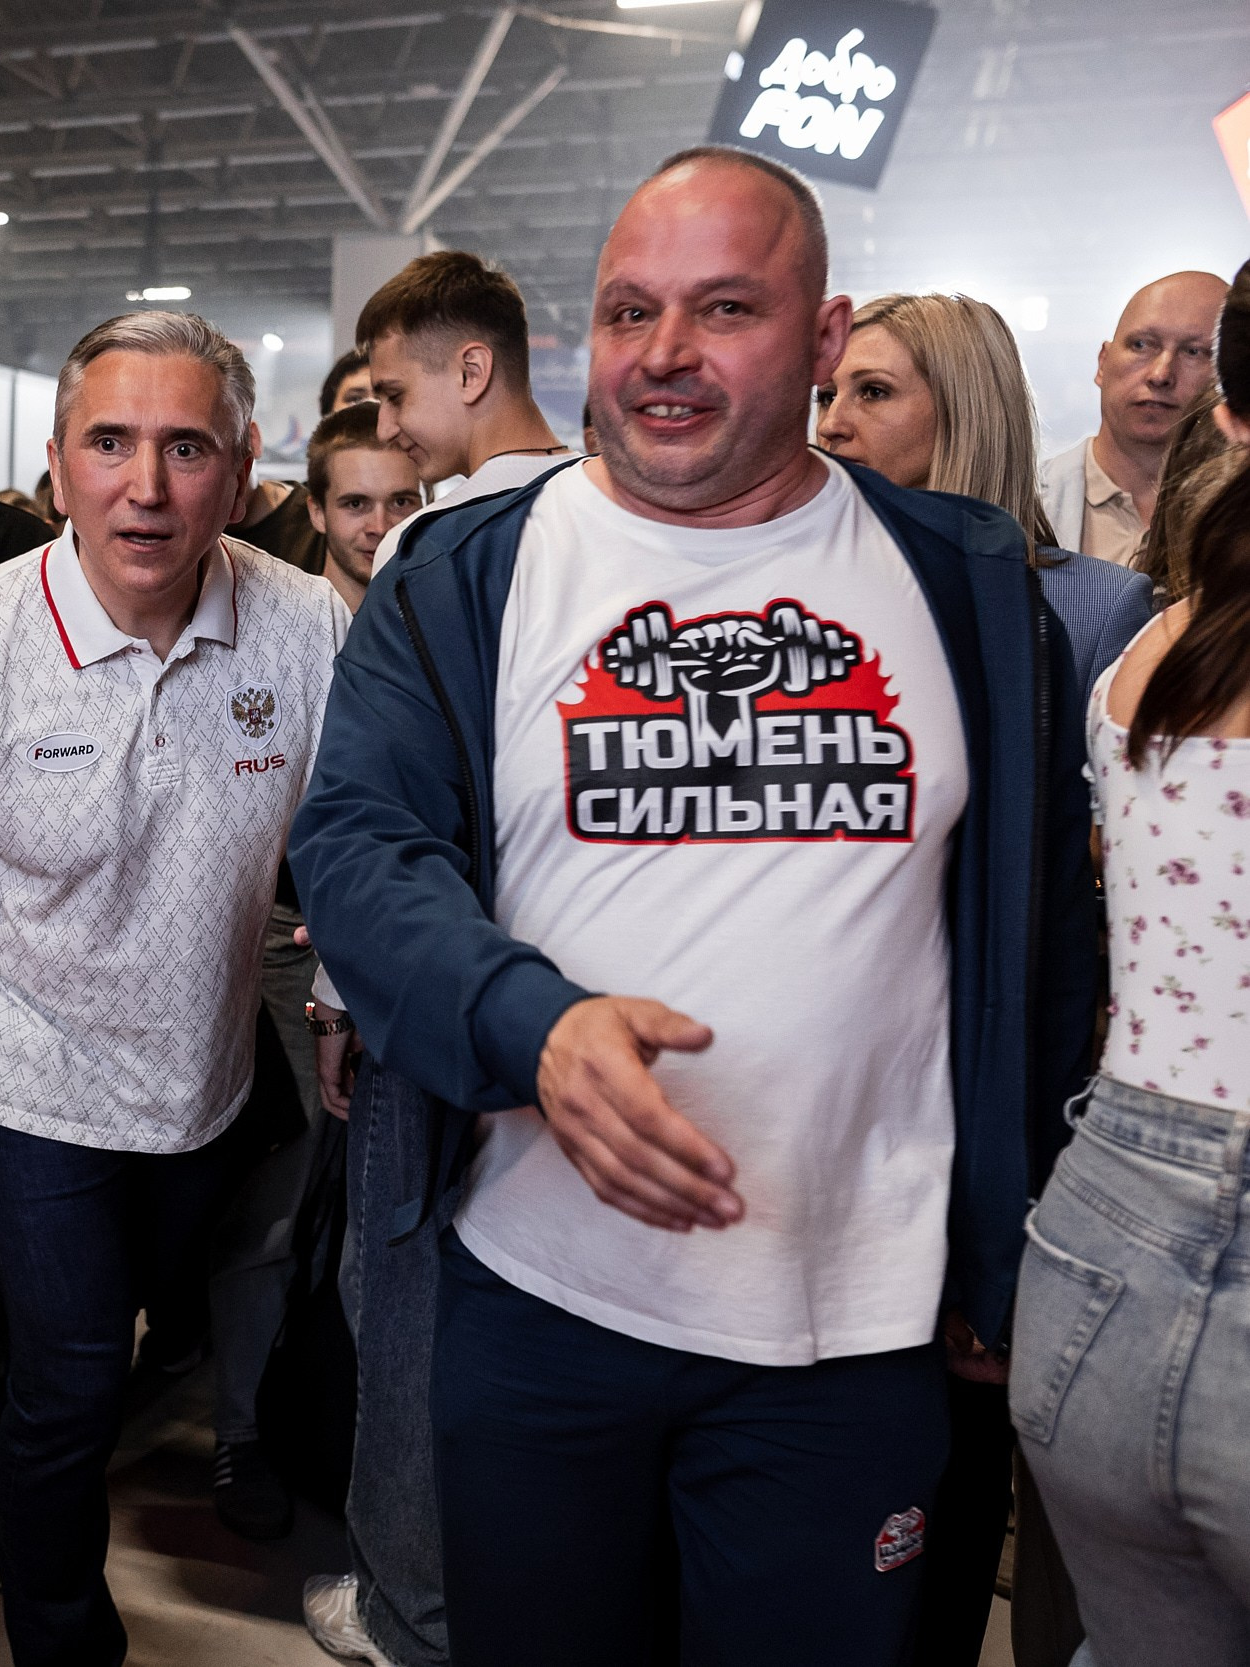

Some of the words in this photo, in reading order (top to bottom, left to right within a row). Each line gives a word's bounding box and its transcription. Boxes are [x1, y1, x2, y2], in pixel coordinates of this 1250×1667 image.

[759, 28, 896, 104] Добро
[739, 88, 885, 160] FON
[34, 744, 94, 760] FORWARD
[235, 753, 286, 776] RUS
[572, 715, 906, 771] ТЮМЕНЬ
[576, 783, 907, 834] СИЛЬНАЯ
